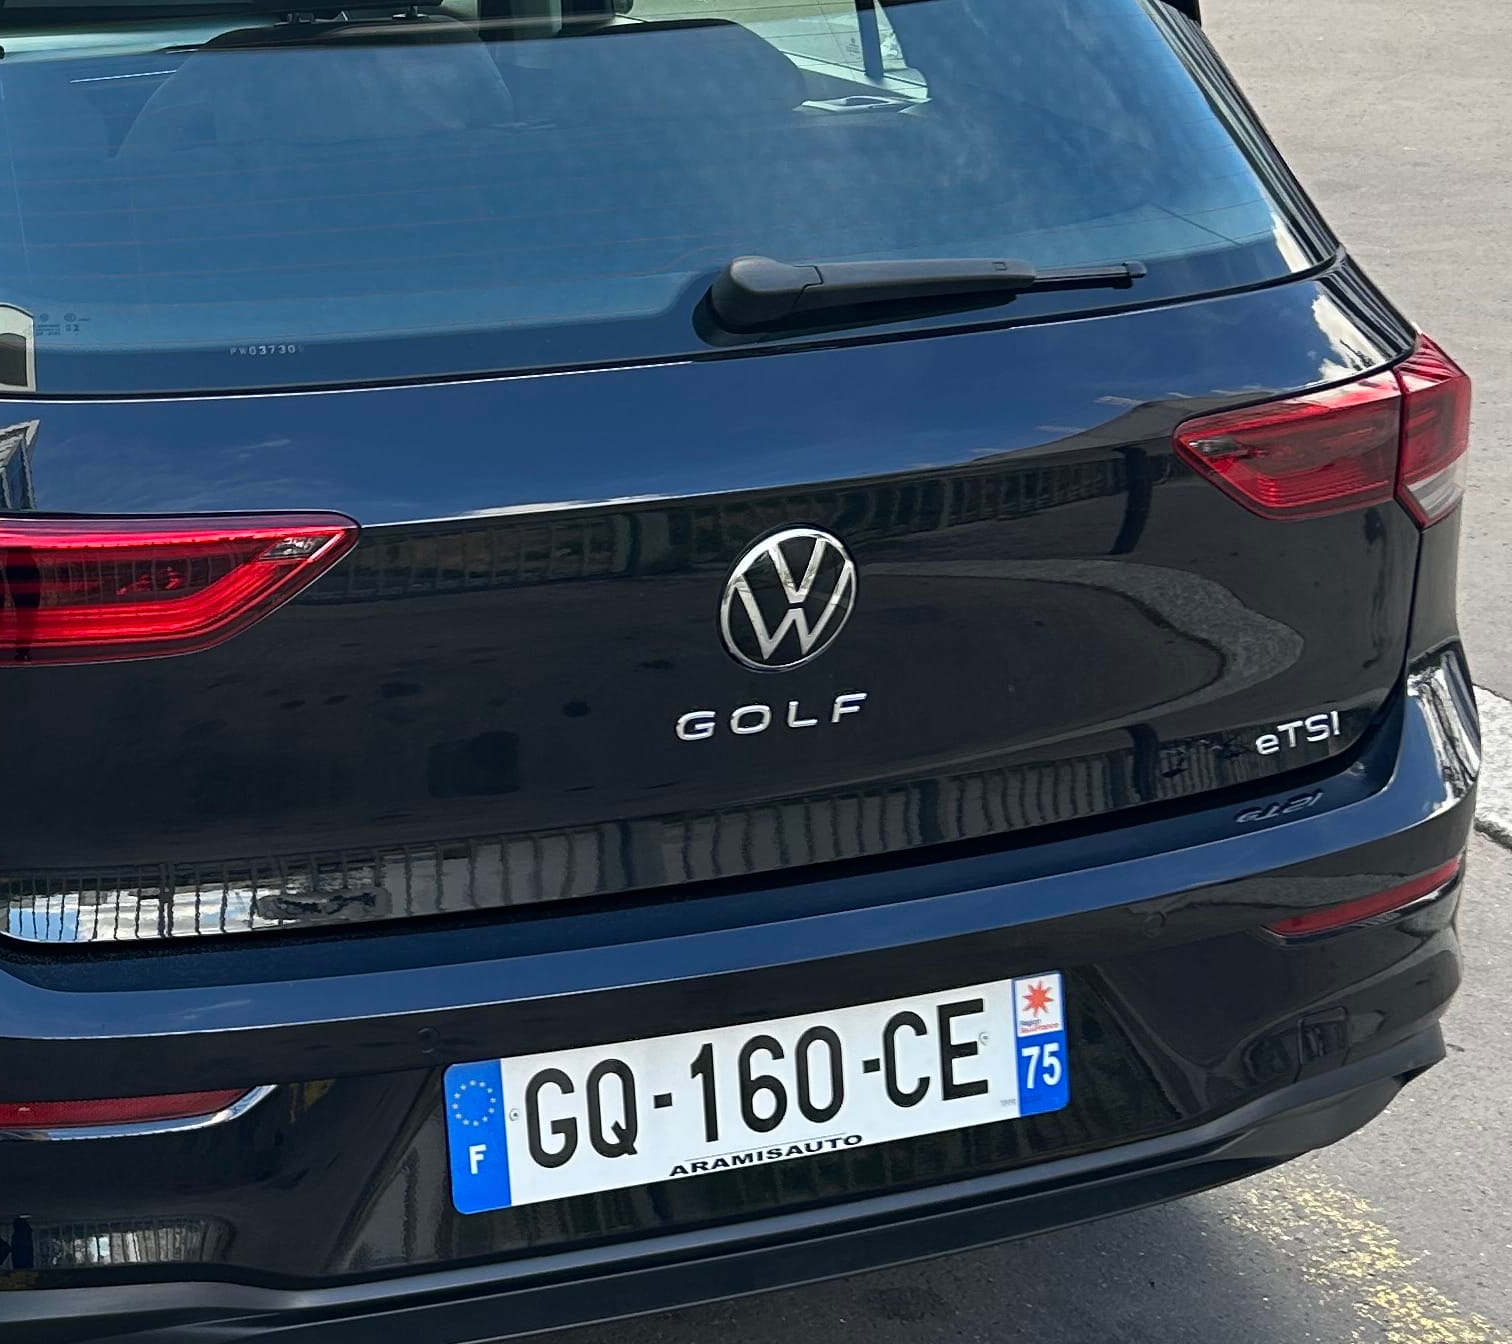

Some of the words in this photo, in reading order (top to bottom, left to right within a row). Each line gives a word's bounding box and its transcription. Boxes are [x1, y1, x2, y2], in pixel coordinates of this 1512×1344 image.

[675, 692, 868, 741] GOLF
[1255, 710, 1340, 755] eTSI
[525, 998, 989, 1169] GQ-160-CE
[1021, 1042, 1062, 1089] 75
[468, 1144, 487, 1175] F
[669, 1134, 864, 1177] ARAMISAUTO
